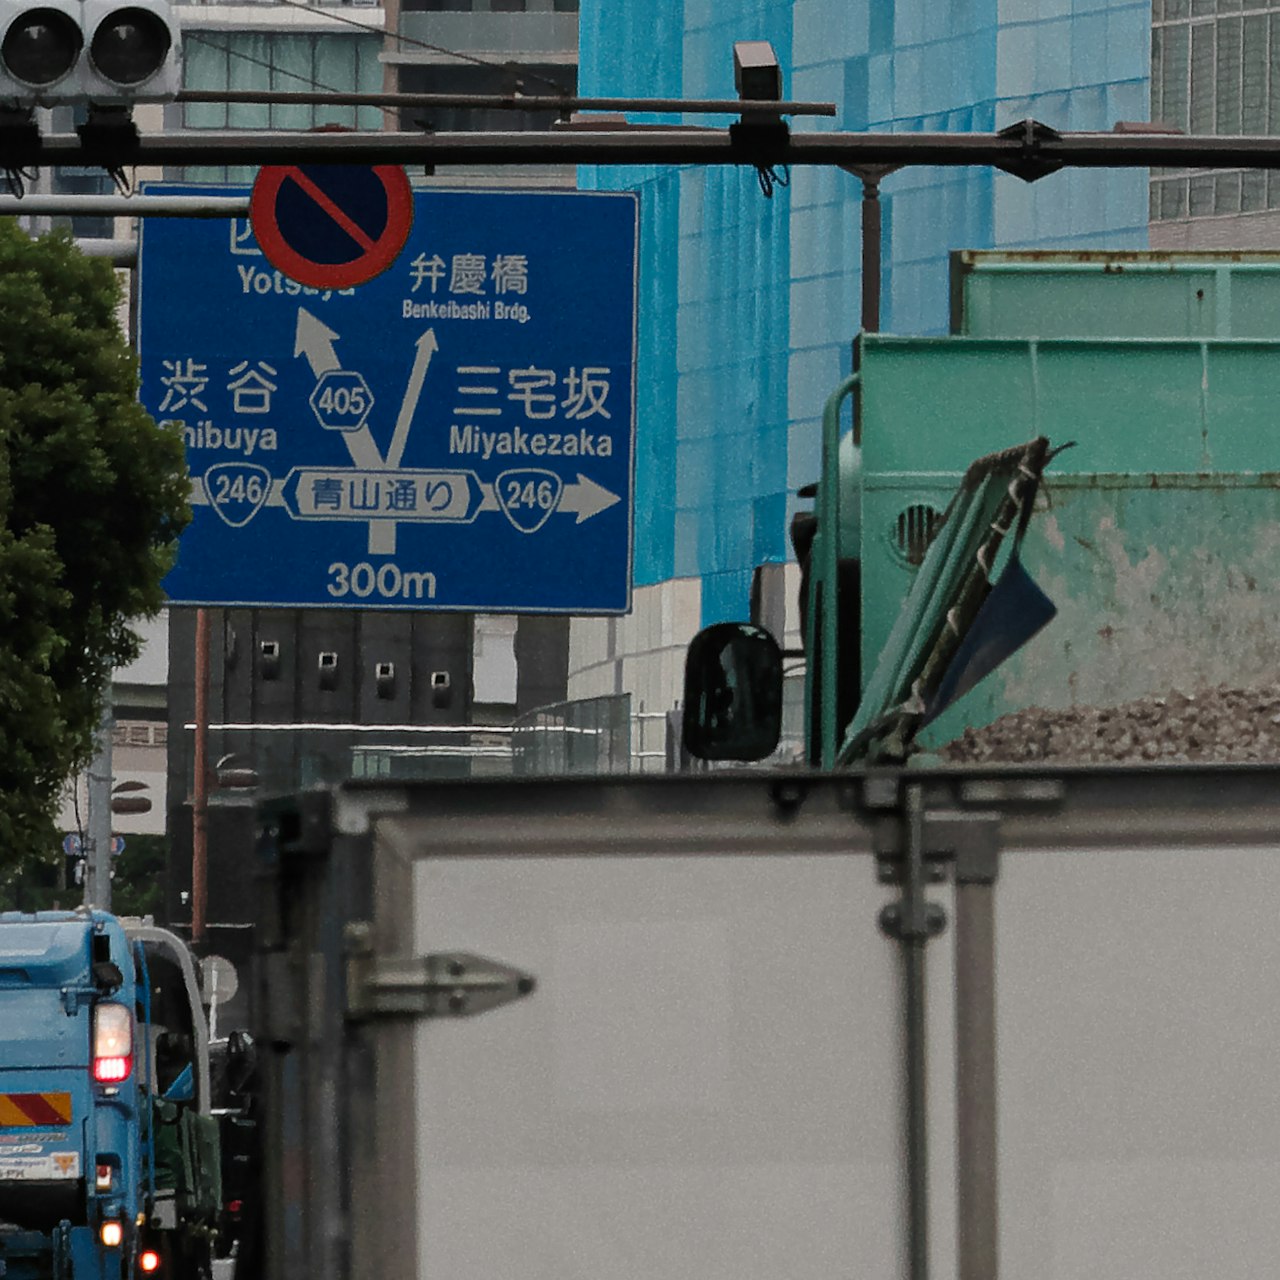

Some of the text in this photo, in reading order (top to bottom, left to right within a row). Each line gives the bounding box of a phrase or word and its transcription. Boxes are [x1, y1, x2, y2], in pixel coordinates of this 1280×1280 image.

[409, 252, 528, 295] 弁慶橋
[402, 299, 531, 324] Benkeibashi Brdg.
[318, 387, 365, 415] 405
[453, 364, 612, 420] 三宅坂
[449, 425, 613, 460] Miyakezaka
[216, 474, 263, 503] 246
[311, 477, 453, 512] 青山通り
[506, 480, 553, 510] 246
[326, 562, 437, 599] 300m
